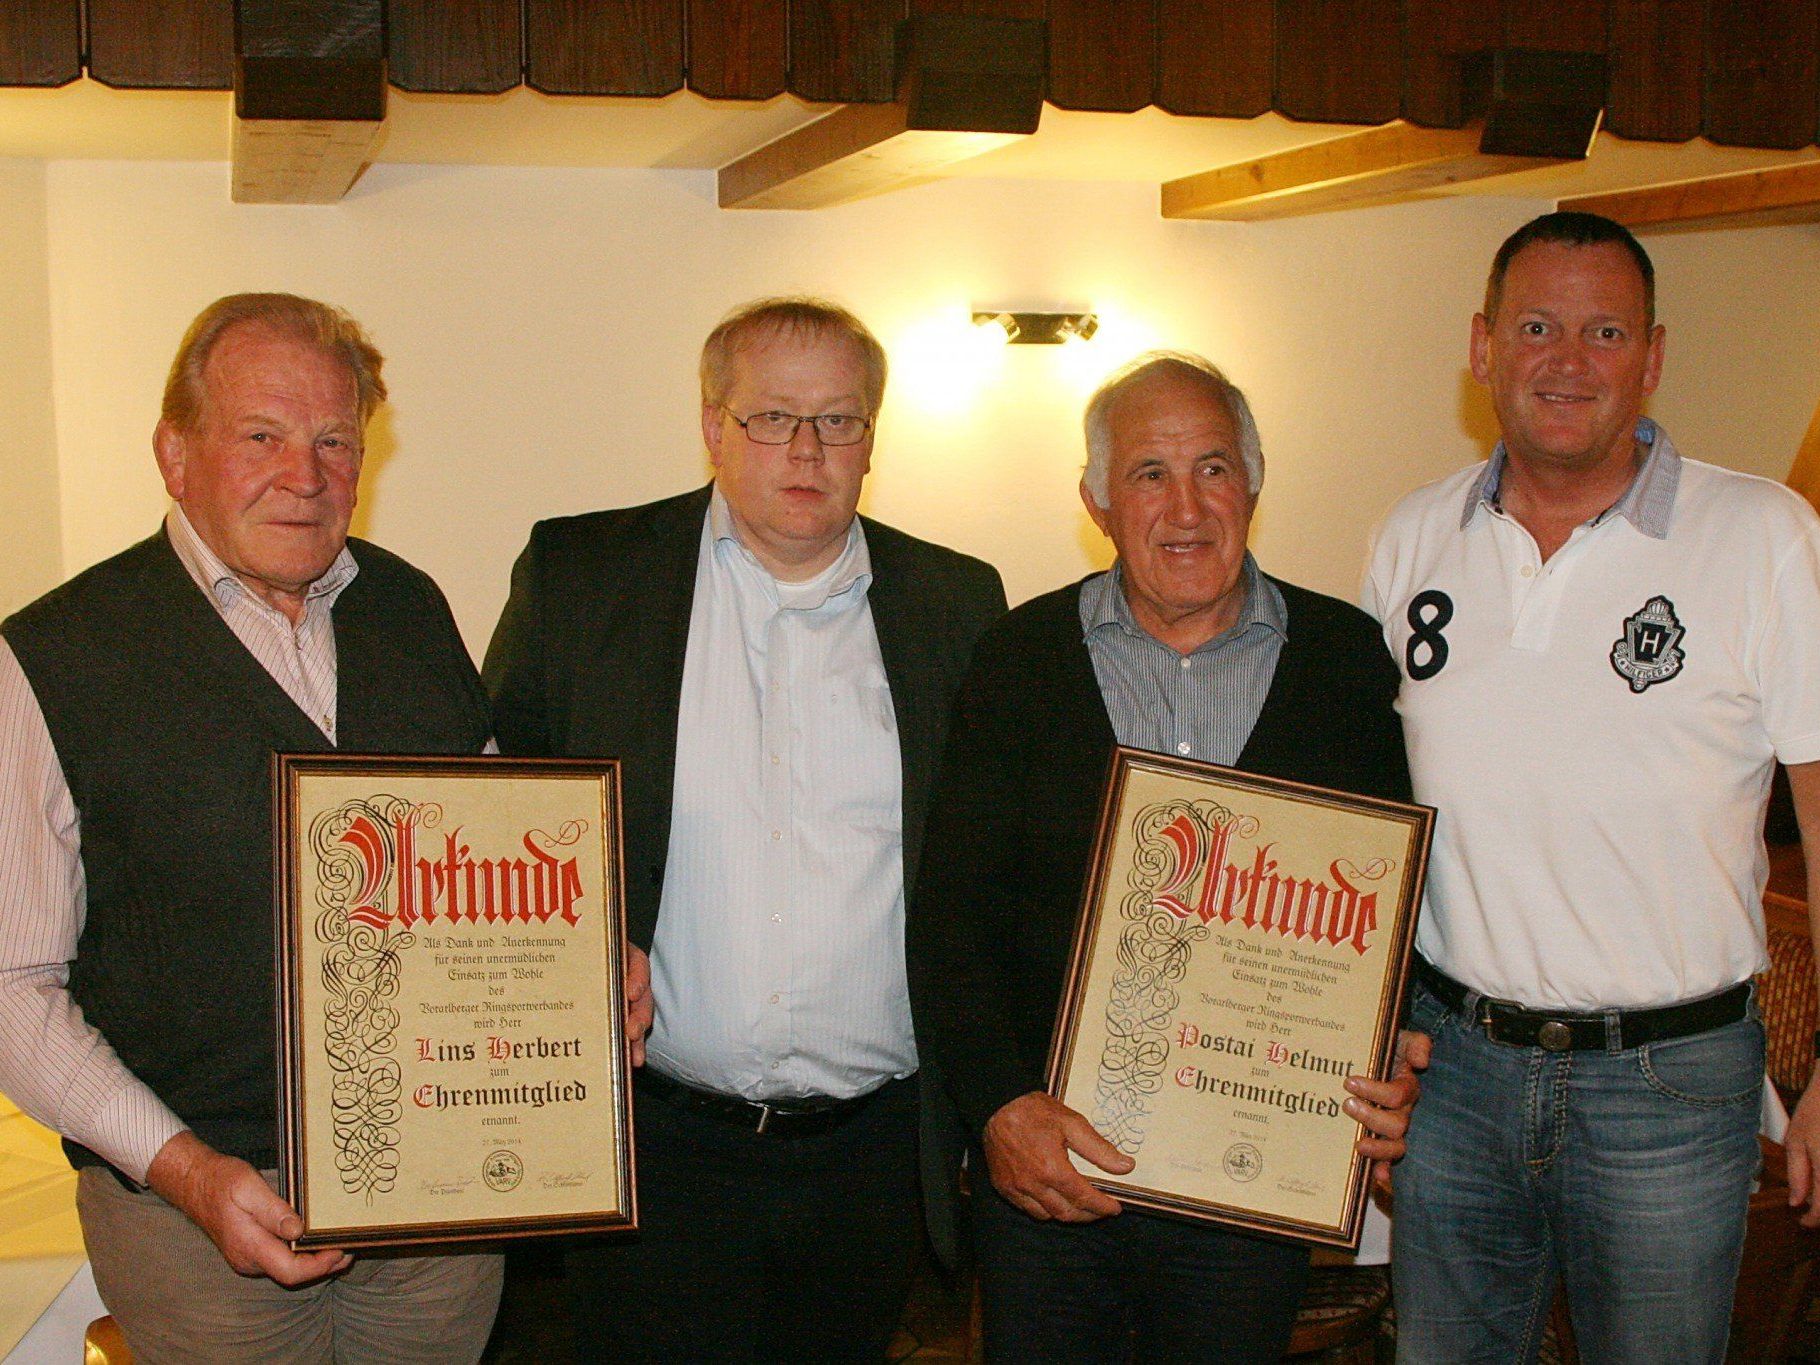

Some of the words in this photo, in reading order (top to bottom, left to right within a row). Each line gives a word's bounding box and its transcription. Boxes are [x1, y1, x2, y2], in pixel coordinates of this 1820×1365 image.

[1406, 590, 1454, 681] 8
[1641, 631, 1660, 655] H
[338, 802, 589, 931] Urkunde
[1151, 814, 1396, 957] Urkunde
[423, 937, 441, 949] Als
[445, 937, 474, 949] Dank
[477, 937, 494, 948] und
[501, 936, 566, 948] Anerkennung
[435, 953, 448, 967] für
[452, 954, 483, 964] seinen
[487, 953, 556, 964] unermüdlichen
[1215, 934, 1232, 948] Als
[1235, 938, 1262, 954] Dank
[1265, 947, 1283, 958] und
[1289, 946, 1351, 973] Anerkennung
[1238, 956, 1269, 969] seinen
[448, 968, 485, 982] Einsatz
[488, 972, 508, 982] zum
[512, 968, 544, 980] Wohle
[1232, 968, 1266, 987] Einsatz
[1270, 978, 1288, 990] zum
[488, 986, 505, 996] des
[1266, 992, 1282, 1004] des
[420, 1002, 479, 1015] Vorarlberger
[474, 1017, 495, 1028] wird
[499, 1017, 522, 1028] Herr
[1246, 1019, 1266, 1031] wird
[416, 1038, 476, 1062] Lins
[487, 1036, 582, 1063] Herbert
[1176, 1021, 1256, 1059] Postai
[1265, 1040, 1355, 1078] Helmut
[490, 1068, 510, 1079] zum
[1251, 1066, 1270, 1078] zum
[413, 1080, 587, 1112] Ehrenmitglied
[1175, 1065, 1340, 1118] Ehrenmitglied
